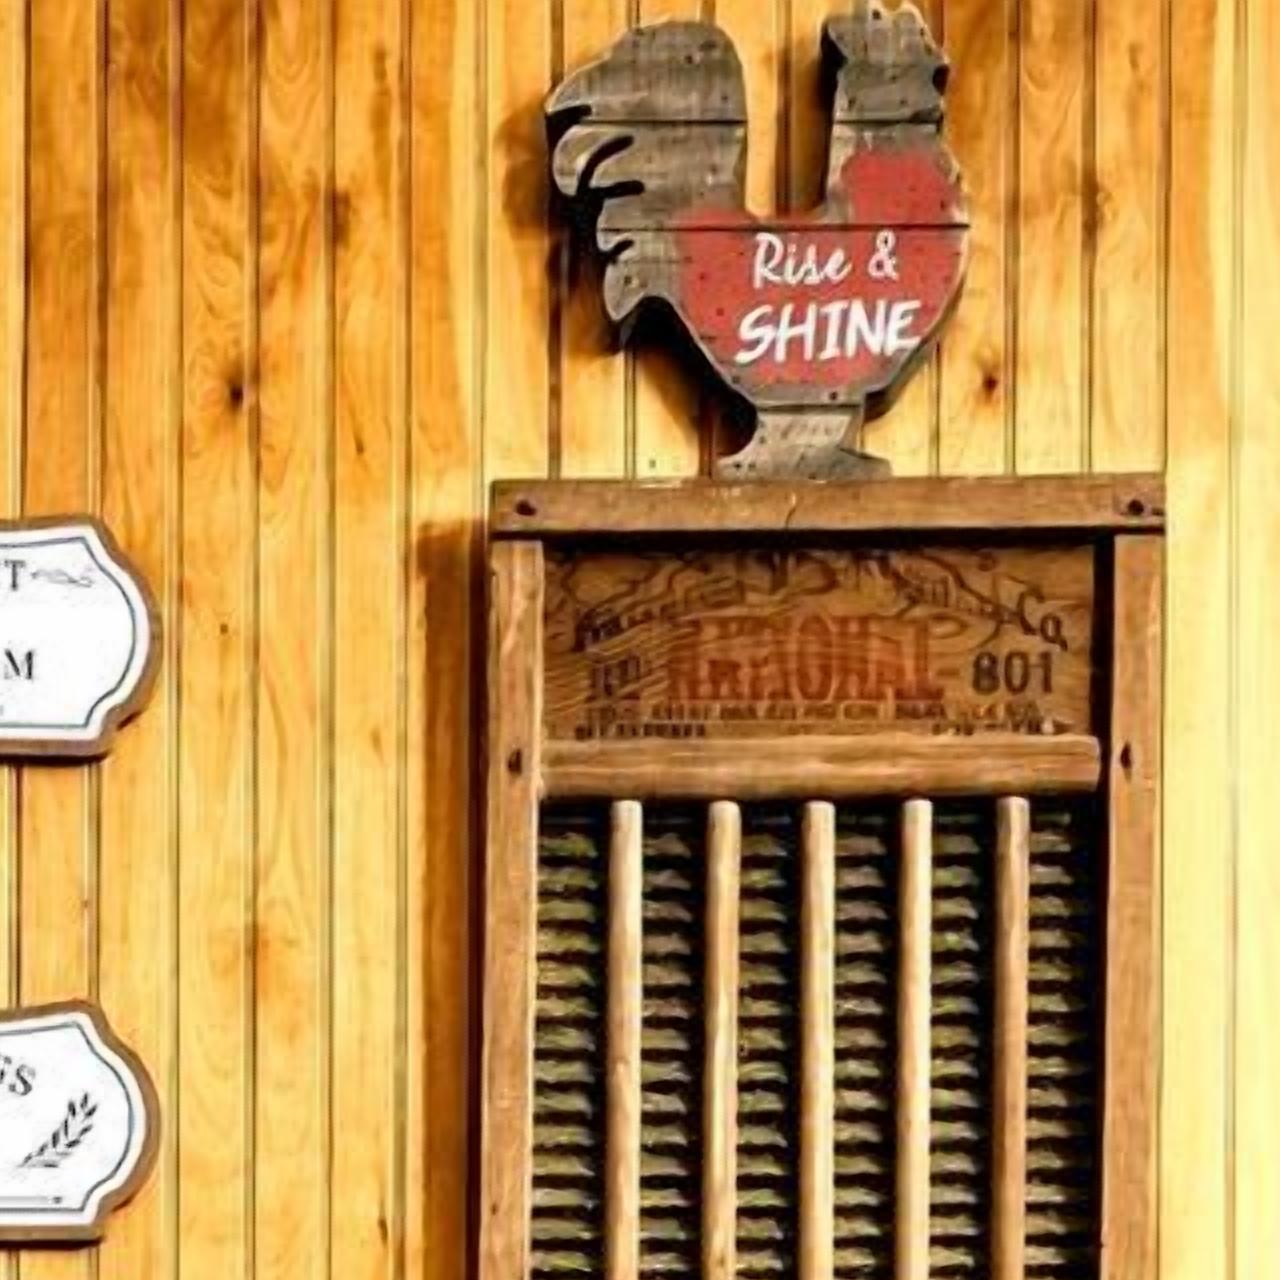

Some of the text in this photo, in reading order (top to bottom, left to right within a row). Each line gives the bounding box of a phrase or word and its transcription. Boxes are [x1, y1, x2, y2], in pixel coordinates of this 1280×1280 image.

[752, 229, 899, 289] Rise &
[733, 298, 922, 364] SHINE
[971, 650, 1053, 696] 801
